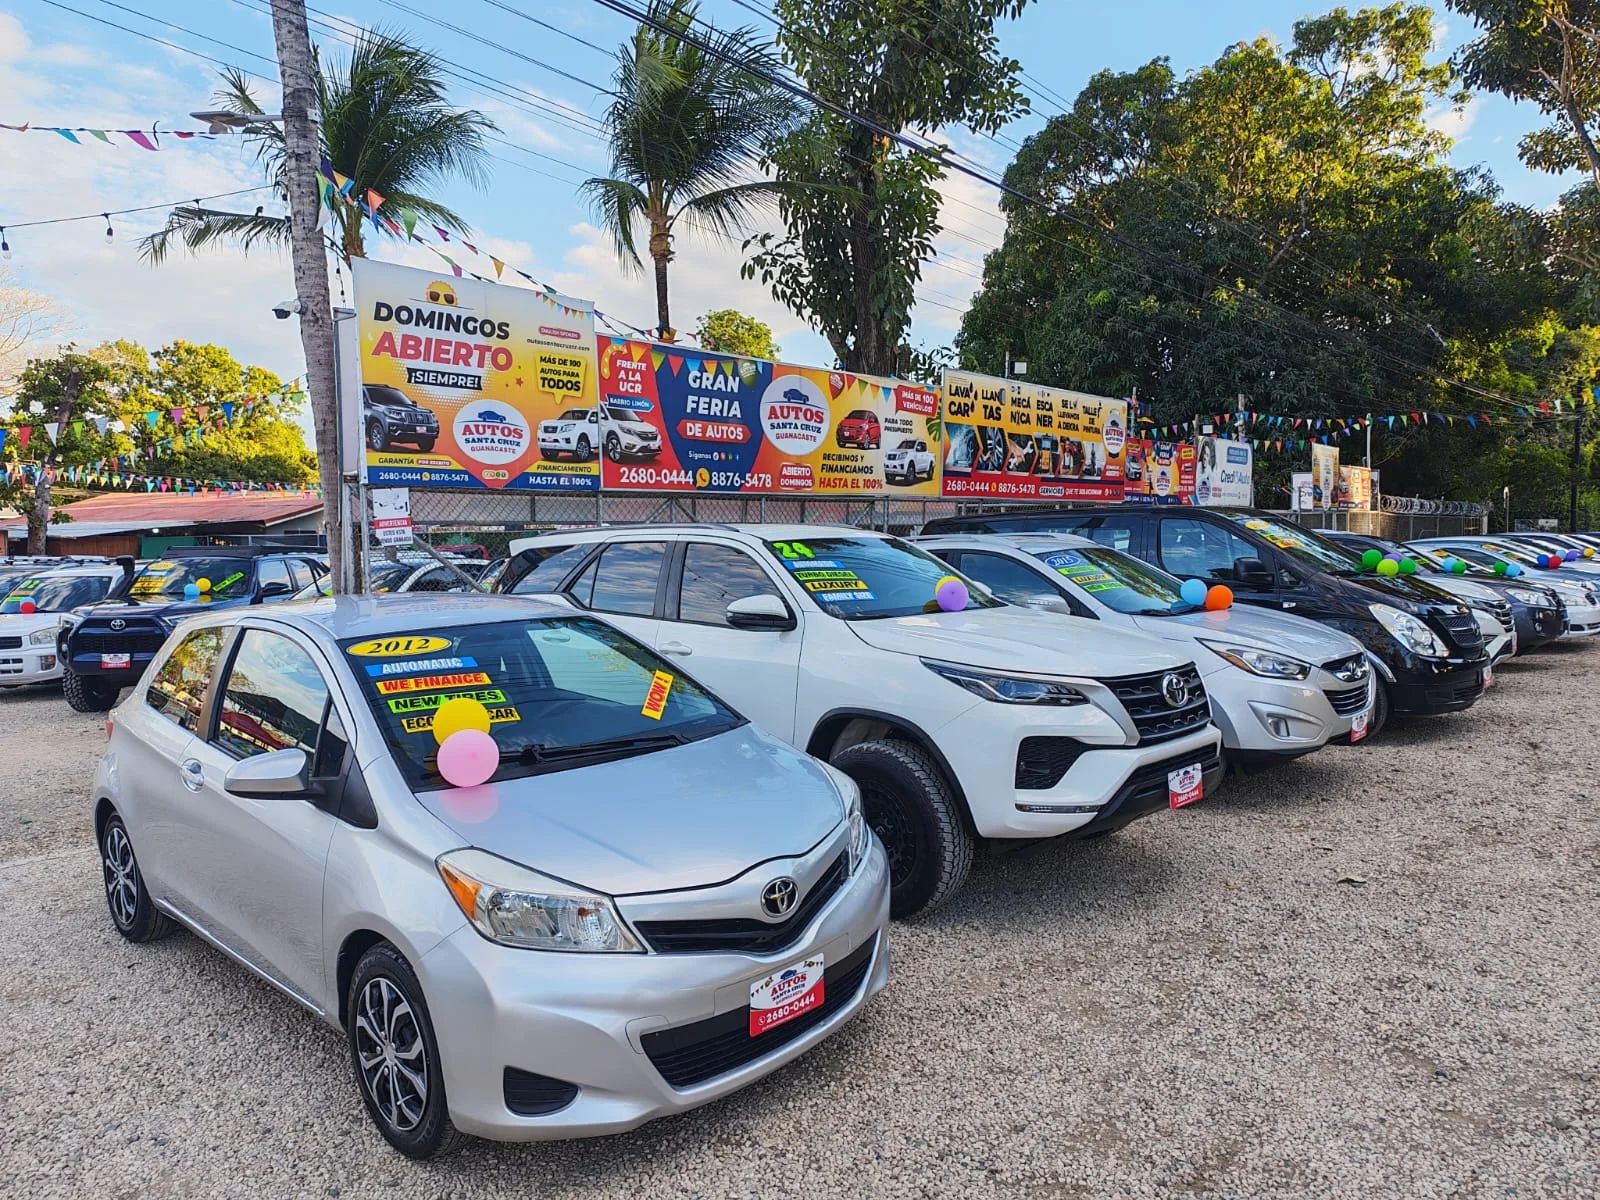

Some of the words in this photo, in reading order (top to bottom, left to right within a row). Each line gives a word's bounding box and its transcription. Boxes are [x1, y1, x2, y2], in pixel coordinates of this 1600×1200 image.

[374, 302, 510, 340] DOMINGOS
[372, 332, 512, 371] ABIERTO
[540, 355, 556, 364] MÁS
[558, 358, 568, 366] DE
[570, 360, 581, 368] 100
[616, 360, 647, 370] FRENTE
[411, 371, 478, 387] ¡SIEMPRE!
[540, 368, 561, 376] AUTOS
[563, 370, 579, 378] PARA
[618, 370, 626, 379] A
[629, 371, 641, 381] LA
[540, 377, 581, 391] TODOS
[619, 381, 642, 393] UCR
[688, 371, 740, 392] GRAN
[949, 384, 970, 398] LAVA
[686, 395, 742, 418] FERIA
[922, 395, 934, 404] 100
[1011, 397, 1030, 408] MECÁ
[1037, 400, 1053, 412] ESCA
[1062, 399, 1068, 408] SE
[768, 406, 824, 424] AUTOS
[949, 401, 970, 417] CAR
[983, 405, 1001, 421] TAS
[770, 422, 798, 430] SANTA
[800, 424, 821, 434] CRUZ
[1036, 414, 1052, 428] NER
[1058, 421, 1062, 429] A
[462, 424, 524, 439] AUTOS
[686, 423, 703, 436] DE
[706, 425, 744, 440] AUTOS
[776, 432, 817, 442] GUANACASTE
[1105, 429, 1123, 437] AUTOS
[465, 437, 491, 445] SANTA
[493, 438, 521, 447] CRUZ
[470, 446, 516, 454] GUANACASTE
[823, 454, 859, 462] RECIBIMOS
[379, 472, 420, 480] 2680-0444
[431, 473, 468, 481] 8876-5478
[782, 467, 810, 476] ABIERTO
[821, 464, 874, 475] FINANCIAMOS
[529, 476, 558, 485] HASTA
[572, 478, 592, 486] 100%
[620, 467, 694, 484] 2680-0444
[712, 472, 772, 487] 8876-5478
[780, 478, 812, 487] DOMINGOS
[819, 478, 849, 488] HASTA
[851, 479, 861, 488] EL
[863, 479, 883, 489] 100%
[946, 480, 989, 492] 2680-0444
[999, 483, 1035, 494] 8876-5478
[772, 542, 815, 558] 24
[367, 638, 430, 653] 2012
[382, 657, 463, 674] AUTOMATIC
[383, 680, 409, 691] WE
[414, 674, 483, 688] FINANCE
[394, 696, 439, 710] NEW
[771, 974, 807, 996] AUTOS
[773, 990, 790, 1001] SANTA
[791, 983, 805, 991] CRUZ
[767, 993, 815, 1023] 2680-0444
